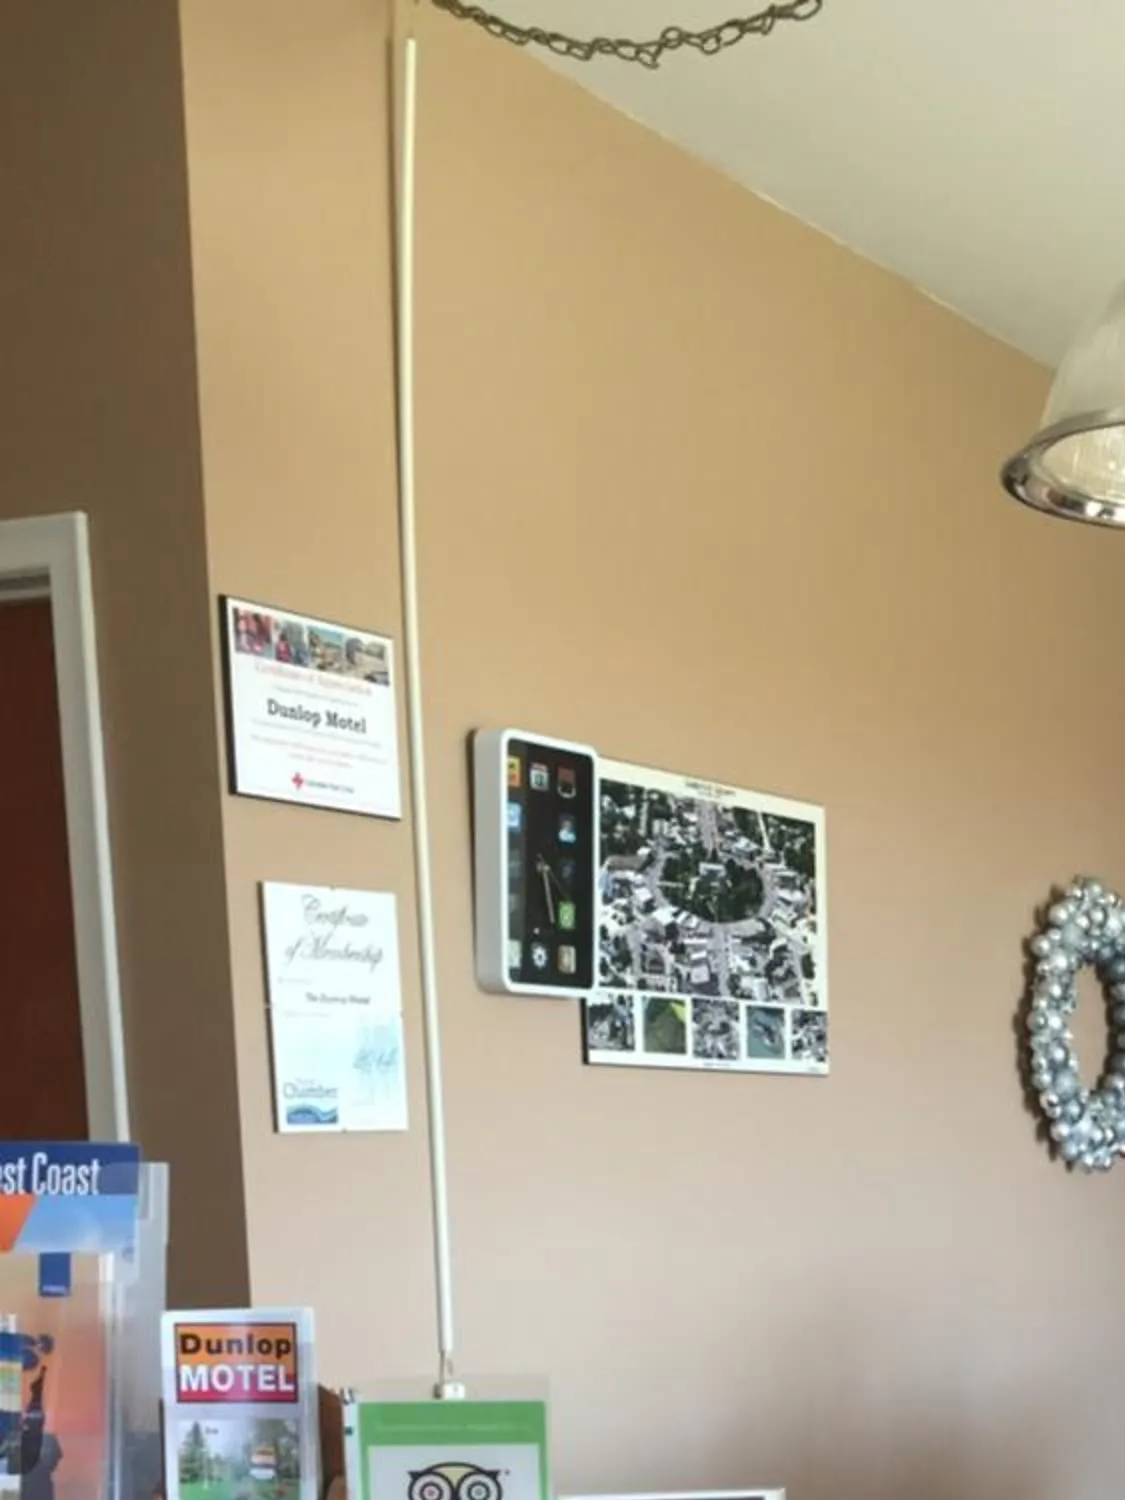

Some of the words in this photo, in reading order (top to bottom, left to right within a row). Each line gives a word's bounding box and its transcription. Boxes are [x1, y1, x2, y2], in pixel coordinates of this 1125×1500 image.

[266, 697, 321, 728] Dunlop
[324, 709, 367, 734] Motel
[0, 1157, 27, 1196] st
[31, 1152, 101, 1197] Coast
[179, 1333, 292, 1359] Dunlop
[180, 1363, 296, 1392] MOTEL
